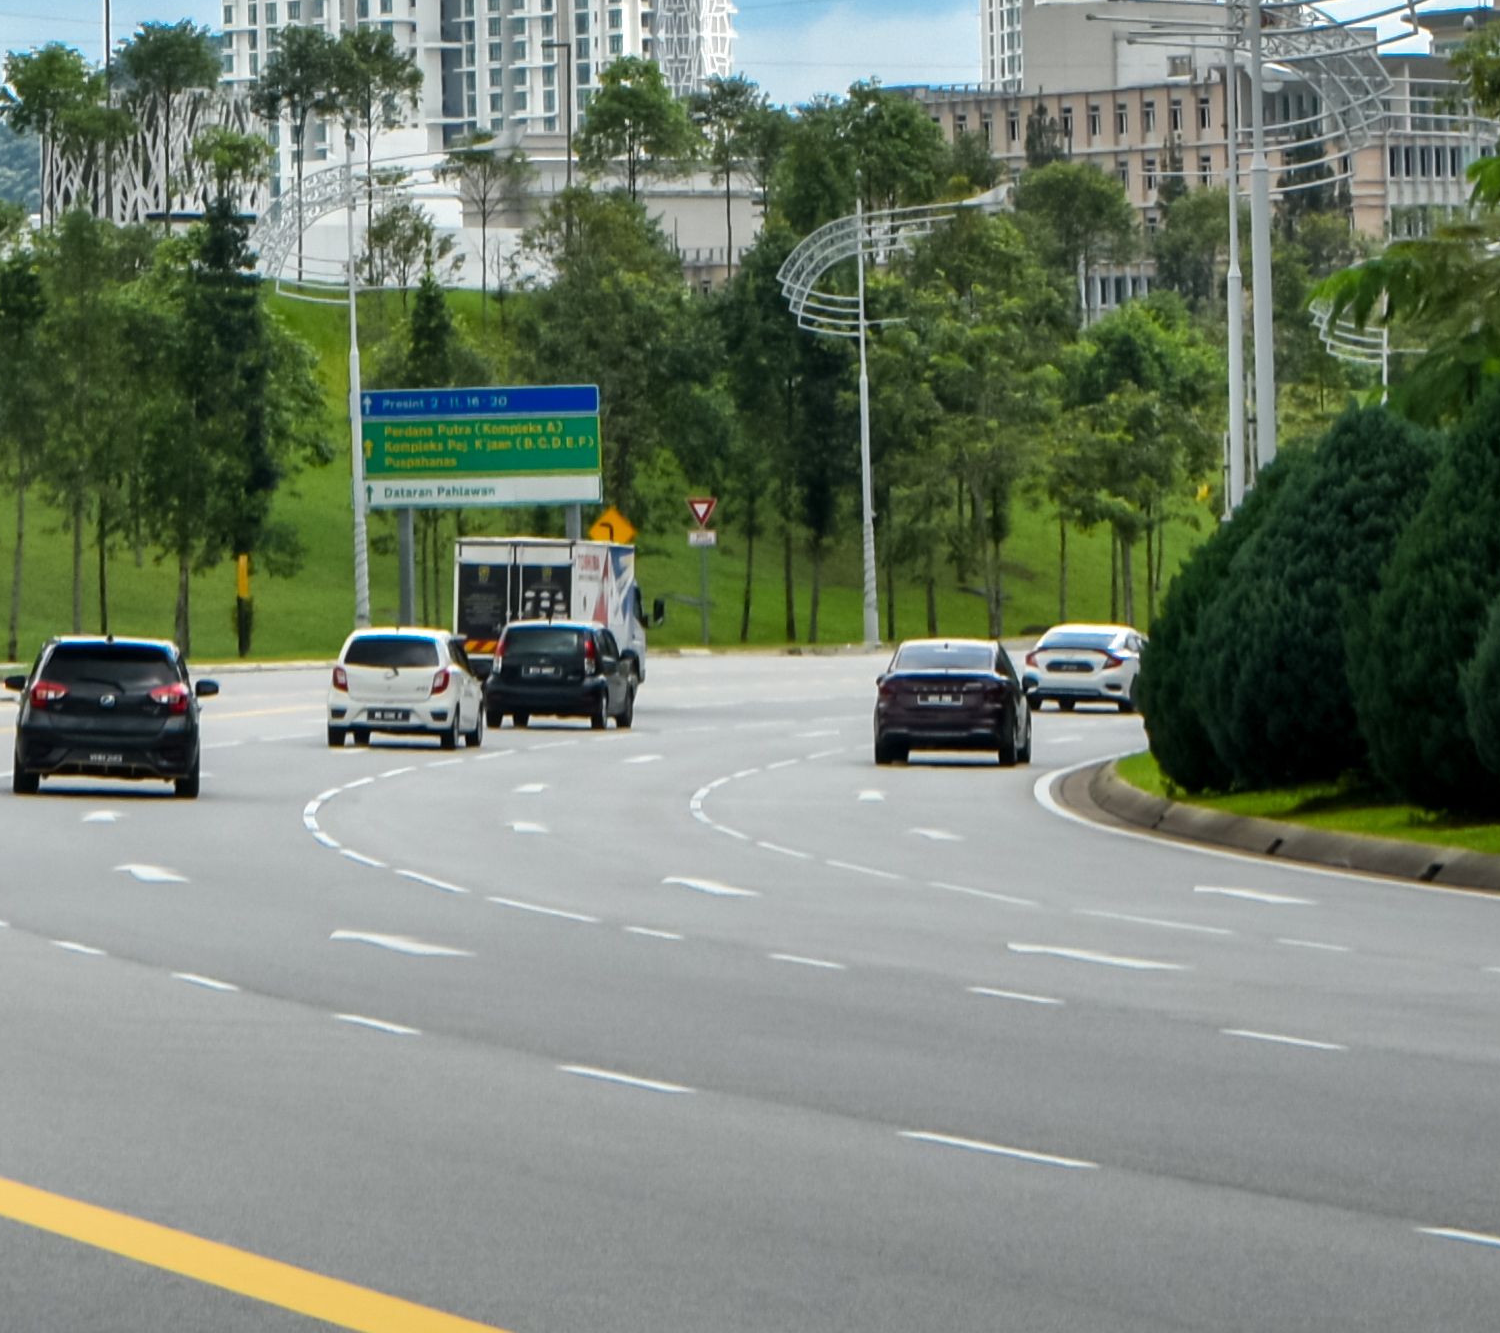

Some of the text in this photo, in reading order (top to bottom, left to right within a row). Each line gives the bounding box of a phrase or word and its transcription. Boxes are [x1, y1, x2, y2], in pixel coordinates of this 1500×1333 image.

[382, 398, 424, 411] Presint
[384, 425, 433, 438] Perdana
[438, 423, 472, 436] Putra
[384, 439, 443, 454] Kompleks
[384, 455, 457, 470] Puspahanas
[384, 485, 496, 499] Dataran Pahlawan
